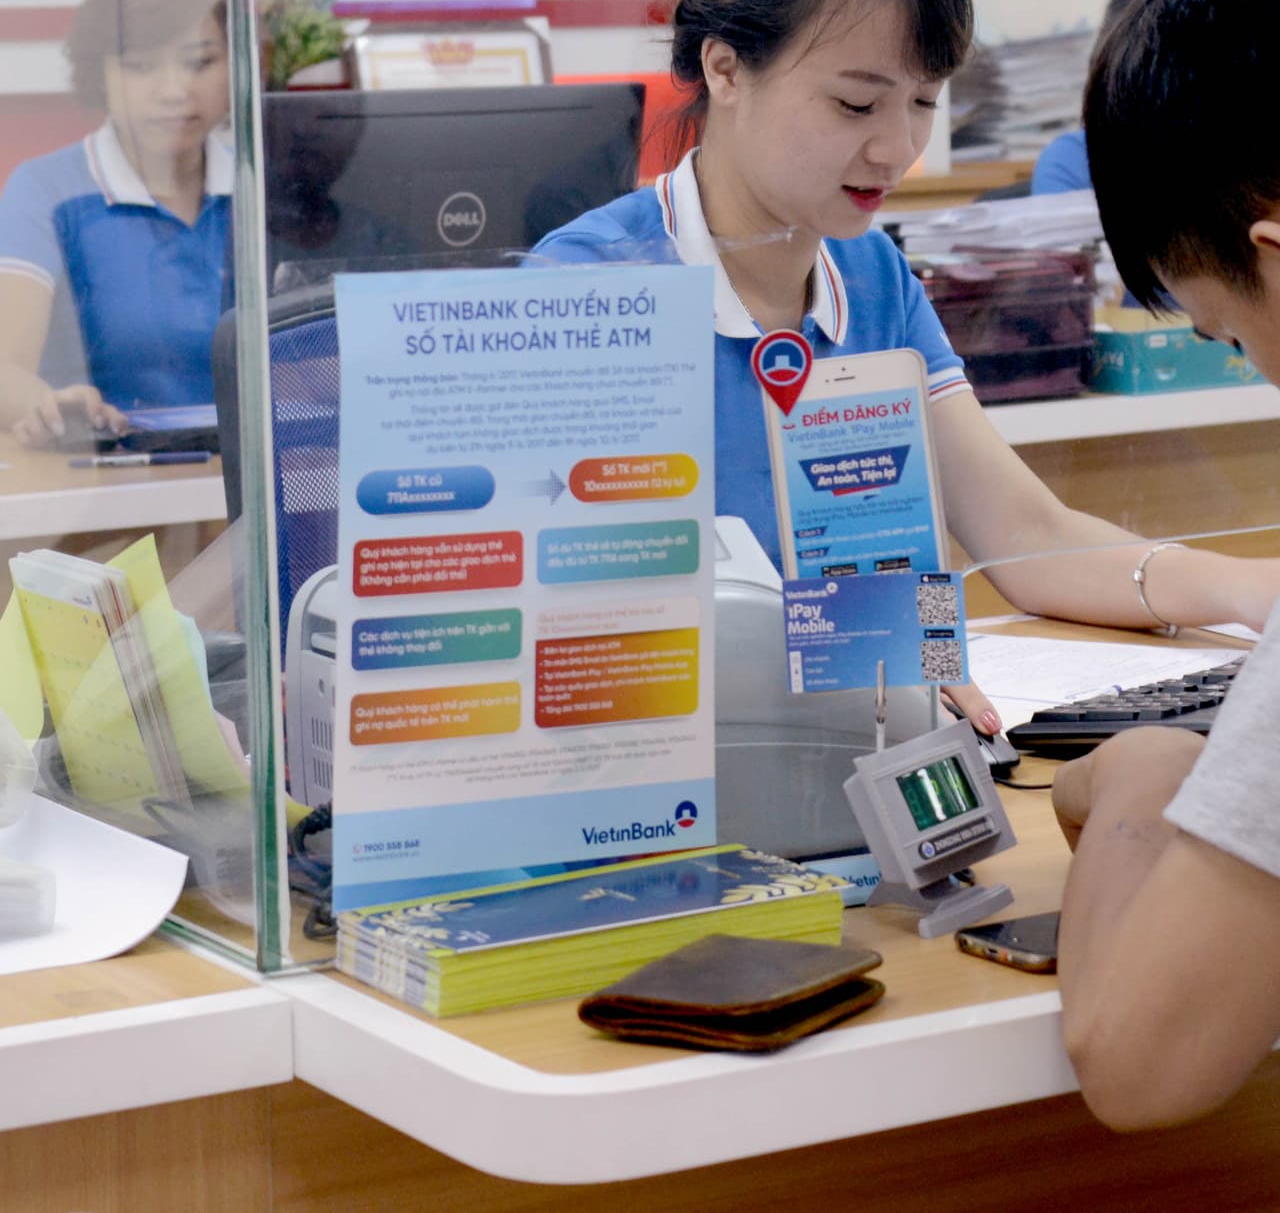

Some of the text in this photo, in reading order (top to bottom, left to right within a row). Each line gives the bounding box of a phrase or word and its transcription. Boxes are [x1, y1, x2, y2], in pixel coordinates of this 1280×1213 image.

[443, 211, 480, 229] DELL
[393, 287, 656, 324] VIETINBANK CHUYỂN ĐỔI
[405, 321, 651, 356] SỐ TÀI KHOẢN THẺ ATM
[802, 397, 912, 427] ĐIỂM ĐĂNG KÝ
[810, 461, 836, 475] Giao
[837, 458, 859, 473] dịch
[817, 474, 832, 486] An
[787, 618, 836, 634] Mobile
[582, 819, 677, 846] VietinBank
